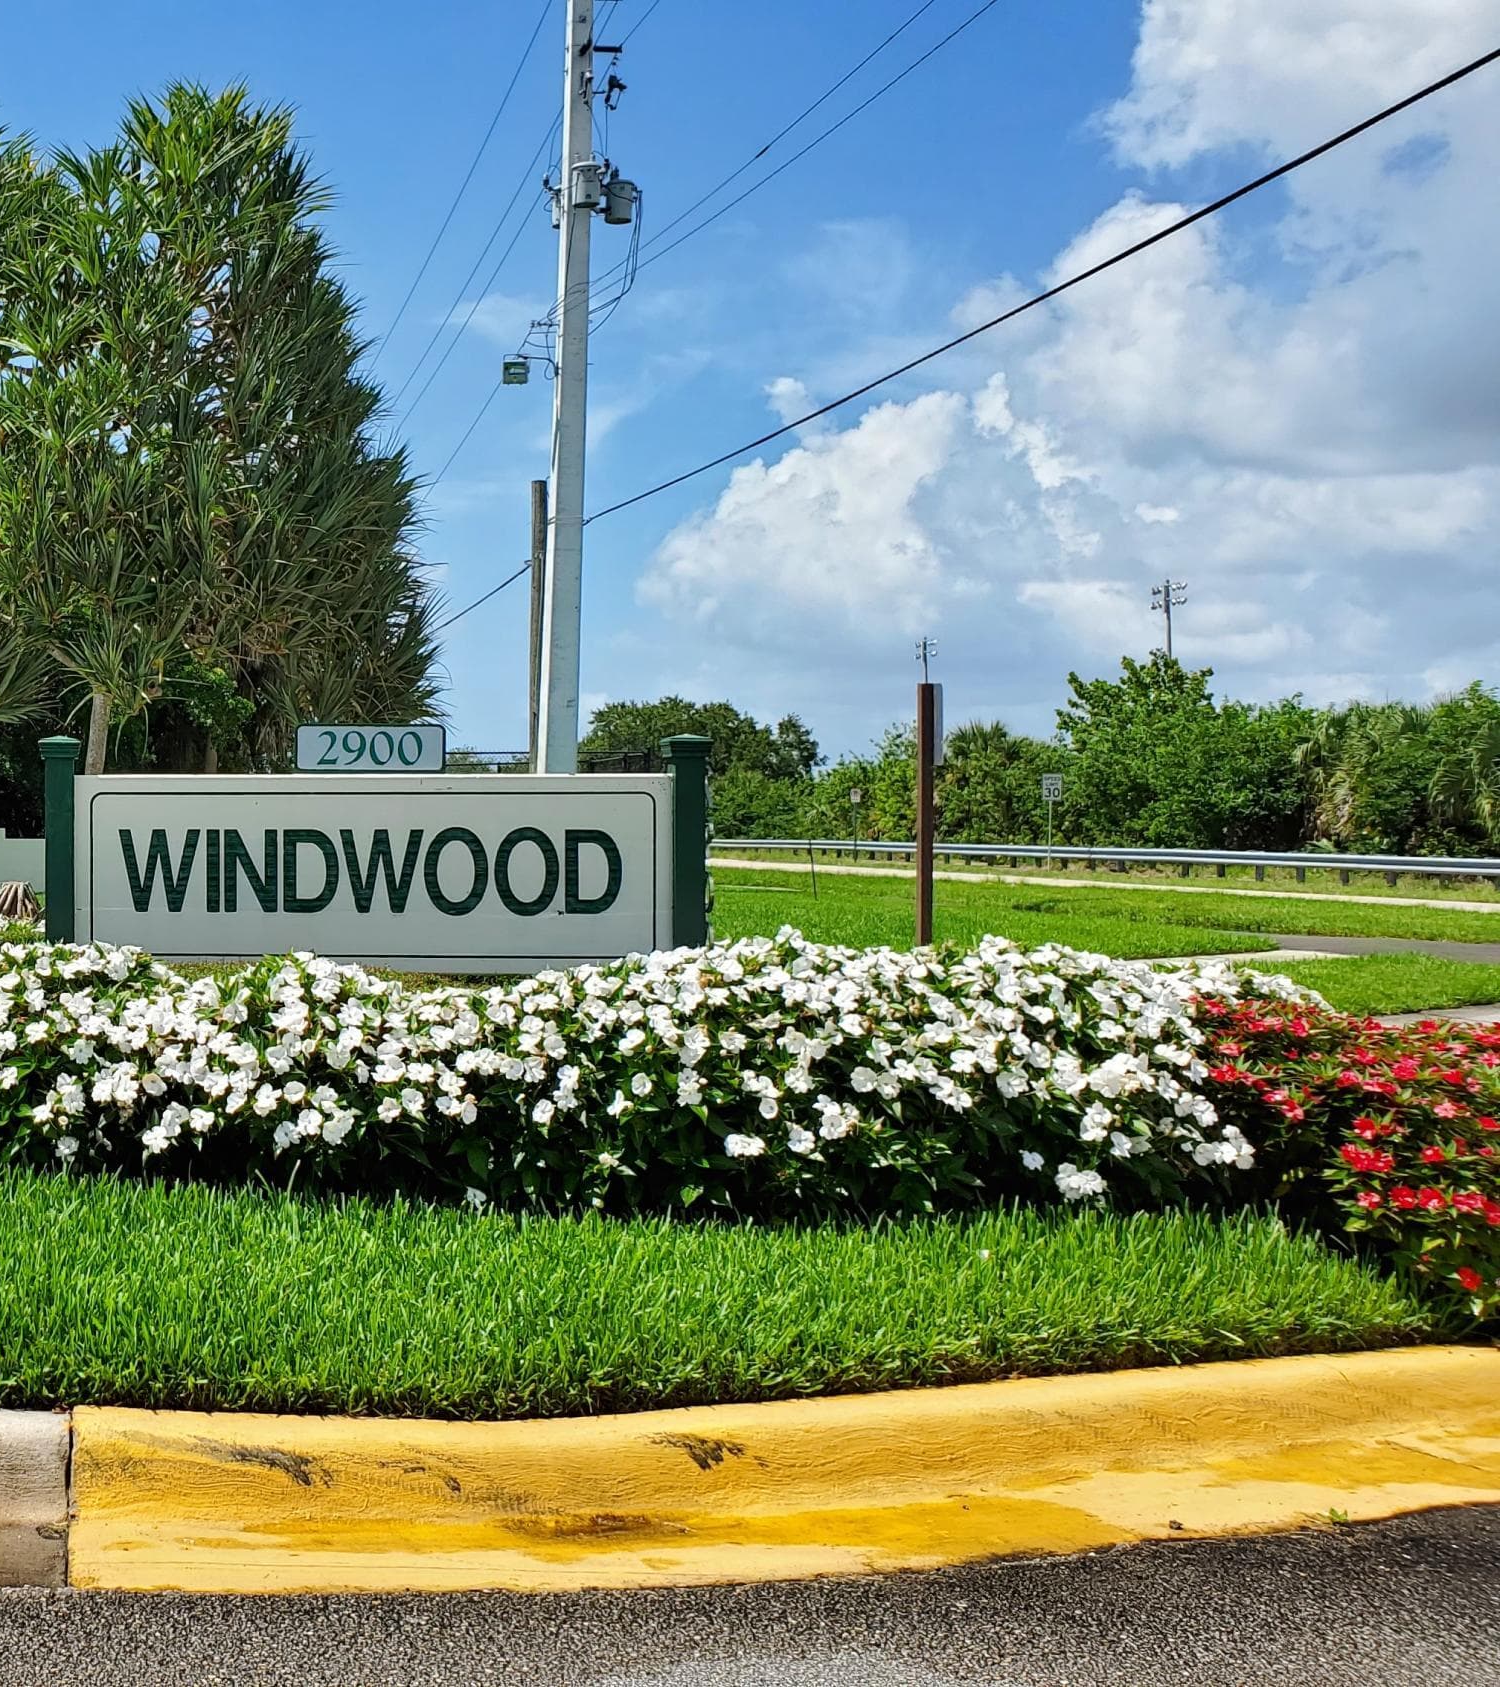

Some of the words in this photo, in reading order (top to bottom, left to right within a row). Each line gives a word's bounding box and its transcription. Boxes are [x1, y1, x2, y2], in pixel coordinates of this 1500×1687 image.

[317, 731, 423, 766] 2900
[1044, 787, 1060, 798] 30
[119, 827, 622, 916] WINDWOOD
